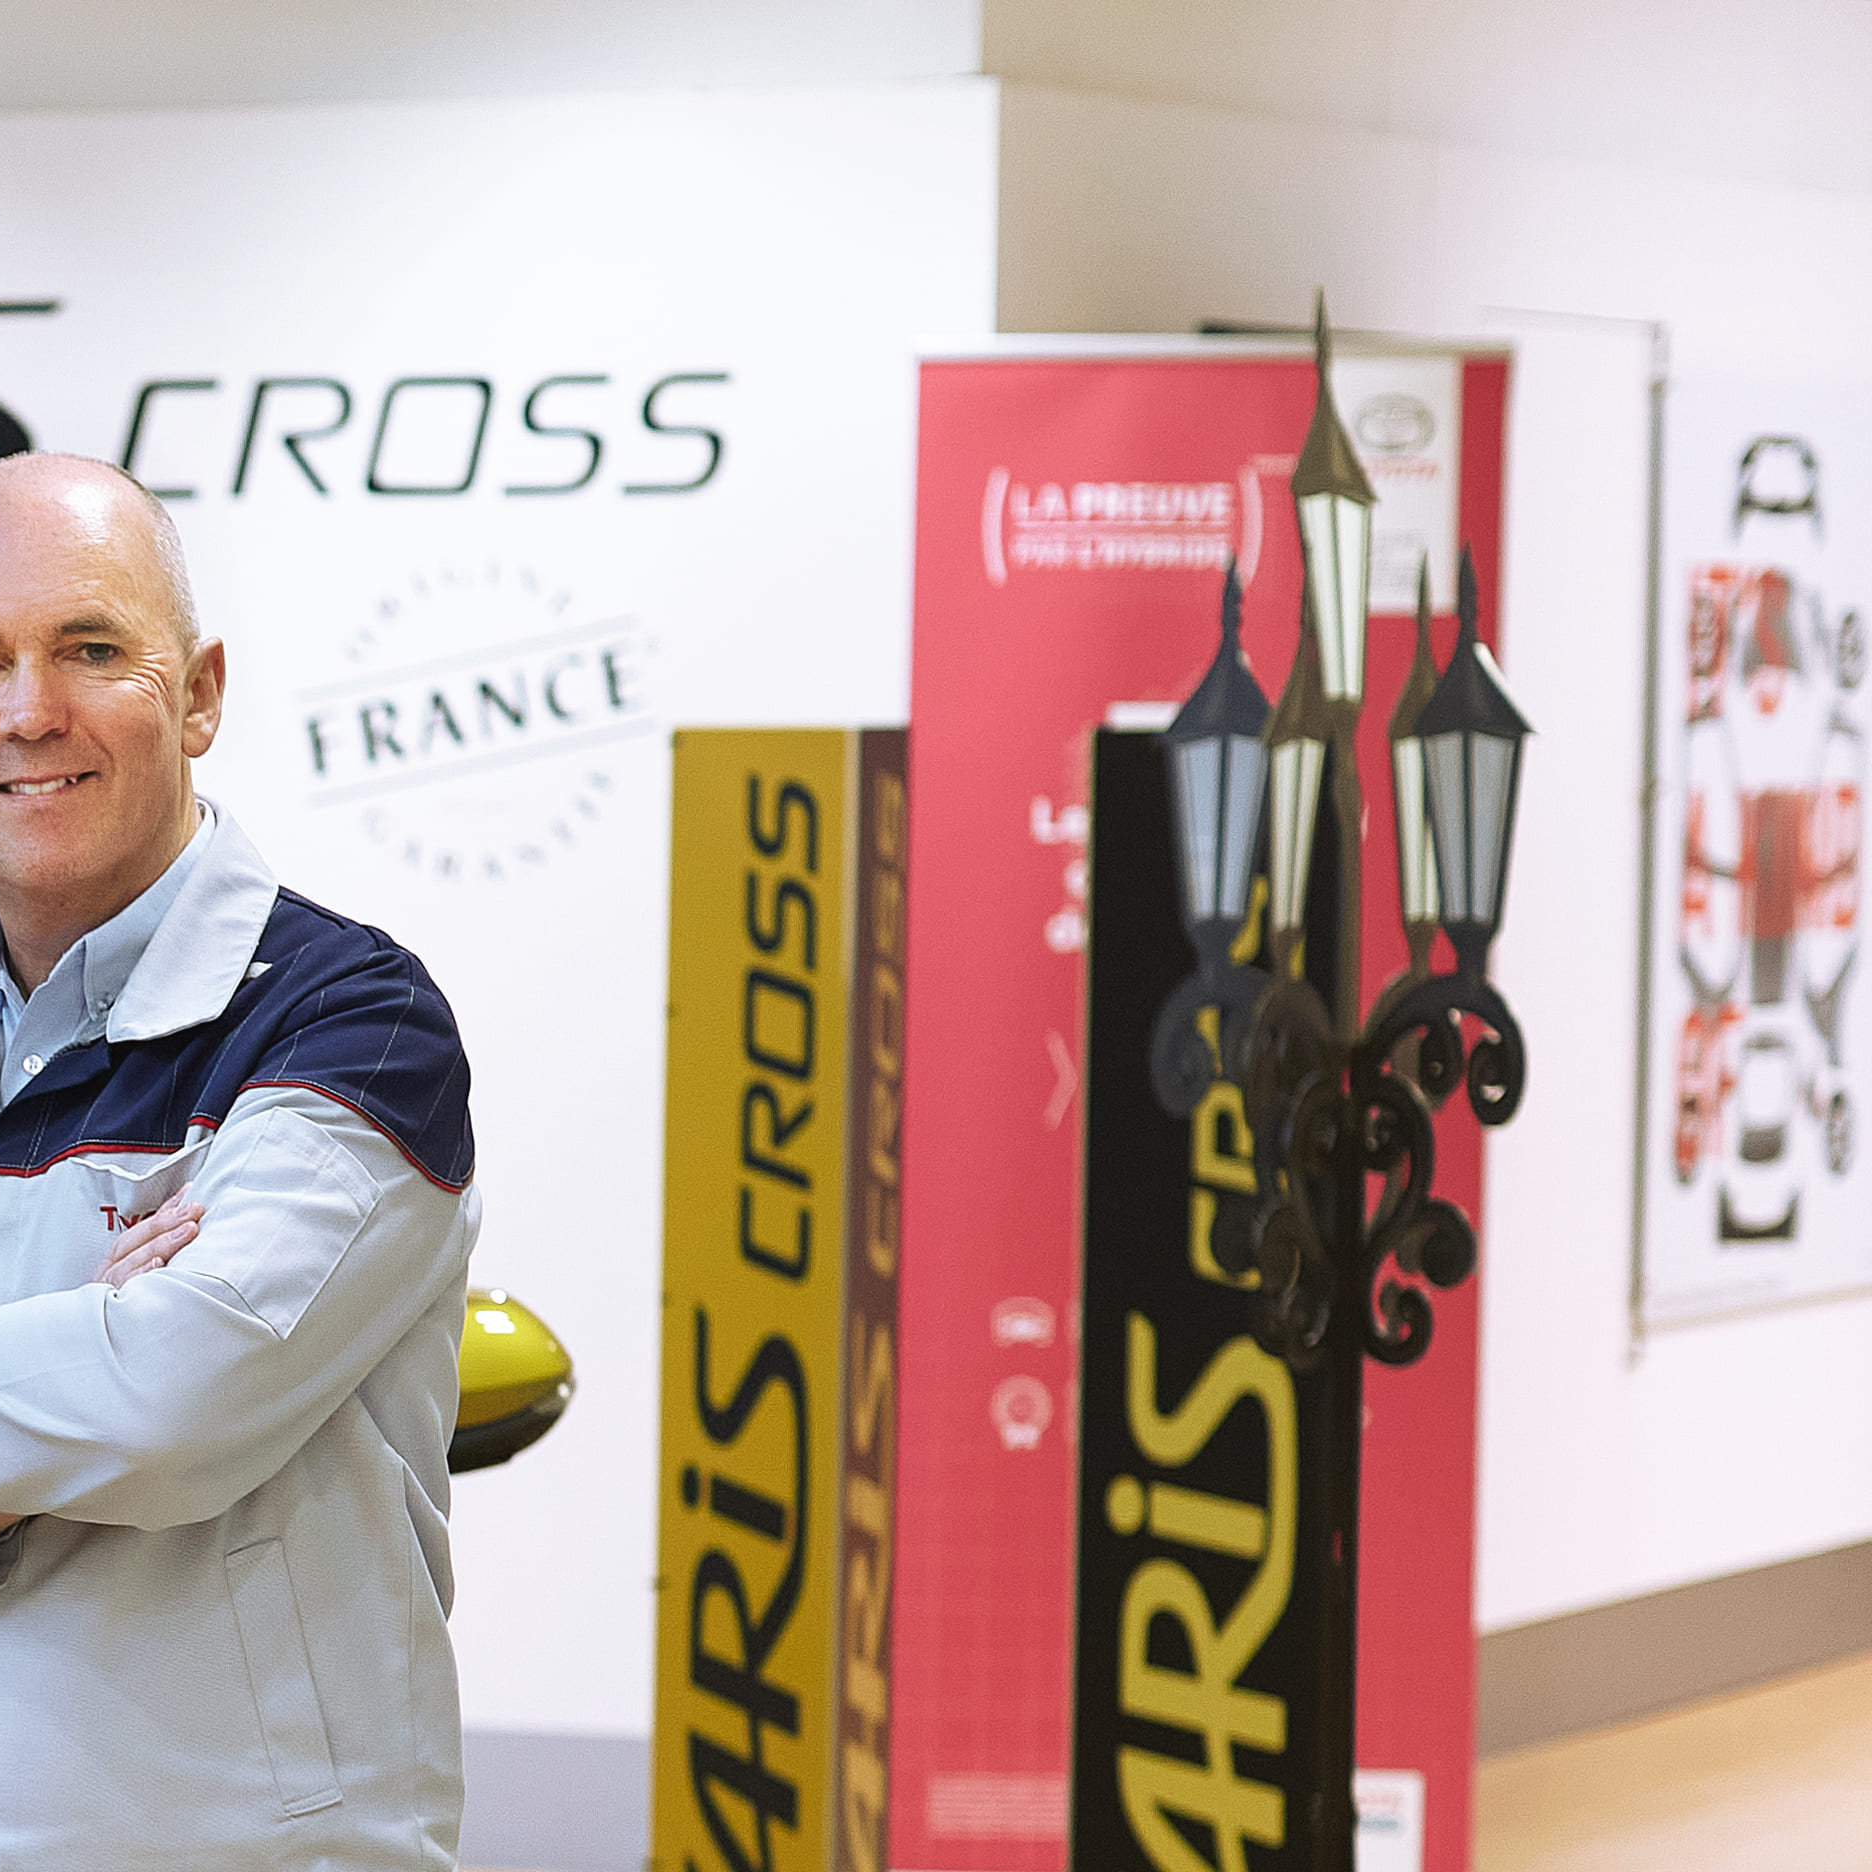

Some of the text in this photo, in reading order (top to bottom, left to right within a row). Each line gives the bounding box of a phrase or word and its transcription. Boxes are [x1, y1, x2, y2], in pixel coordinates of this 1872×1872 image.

[121, 372, 730, 498] CROSS
[306, 643, 640, 776] FRANCE
[739, 773, 819, 1284] CROSS
